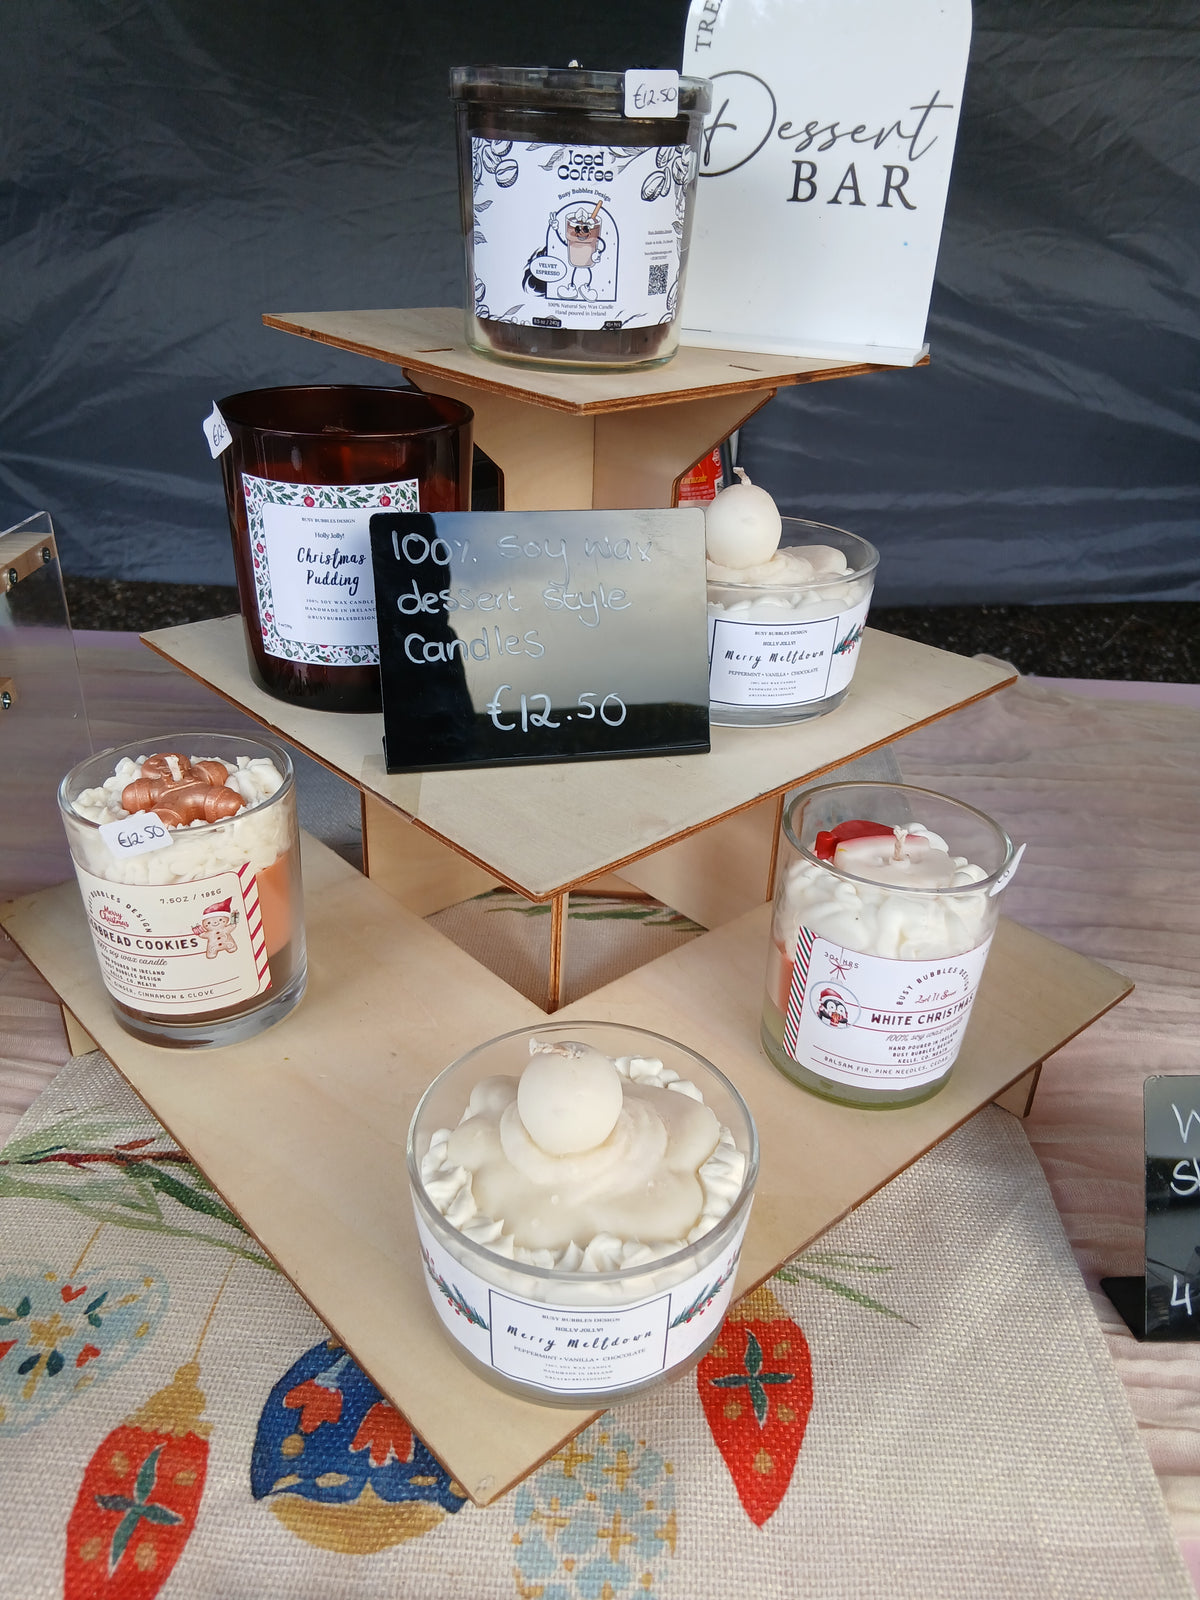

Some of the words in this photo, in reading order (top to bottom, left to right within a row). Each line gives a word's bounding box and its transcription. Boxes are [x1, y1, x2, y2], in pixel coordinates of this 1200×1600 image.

[632, 82, 678, 110] €12.50
[699, 70, 954, 178] Dessert
[568, 150, 605, 166] Iced
[557, 165, 614, 182] Coffee
[786, 160, 917, 211] BAR
[535, 269, 561, 277] ESPRESSO
[538, 262, 558, 270] VELVET
[314, 532, 329, 540] Holly
[330, 532, 345, 540] Jolly!
[297, 547, 367, 569] Christmas
[584, 536, 652, 562] wax
[306, 569, 360, 596] Pudding
[396, 579, 522, 614] dessert
[403, 625, 546, 664] Candles
[724, 650, 762, 670] Merry
[768, 649, 825, 664] Meltdown
[727, 669, 761, 678] PEPPERMINT
[790, 667, 819, 677] CHOCOLATE
[485, 684, 628, 732] €12.50
[117, 825, 165, 848] €12.50
[102, 905, 123, 920] Merry
[125, 903, 153, 933] DESIGN
[135, 938, 199, 951] COOKIES
[138, 958, 168, 966] candle
[137, 990, 177, 1000] CINNAMON
[187, 988, 215, 998] CLOVE
[895, 985, 913, 1006] BUSY
[916, 966, 958, 984] BUBBLES
[870, 1013, 913, 1026] WHITE
[917, 992, 974, 1025] CHRISTMAS
[907, 1042, 932, 1050] POURED
[911, 1046, 936, 1056] BUBBLES
[824, 1055, 854, 1070] BALSAM
[856, 1066, 872, 1074] FIR,
[1170, 1274, 1193, 1316] 4
[506, 1324, 556, 1352] Merry
[567, 1330, 652, 1351] Meltdown
[513, 1345, 558, 1361] PEPPERMINT
[602, 1347, 647, 1362] CHOCOLATE
